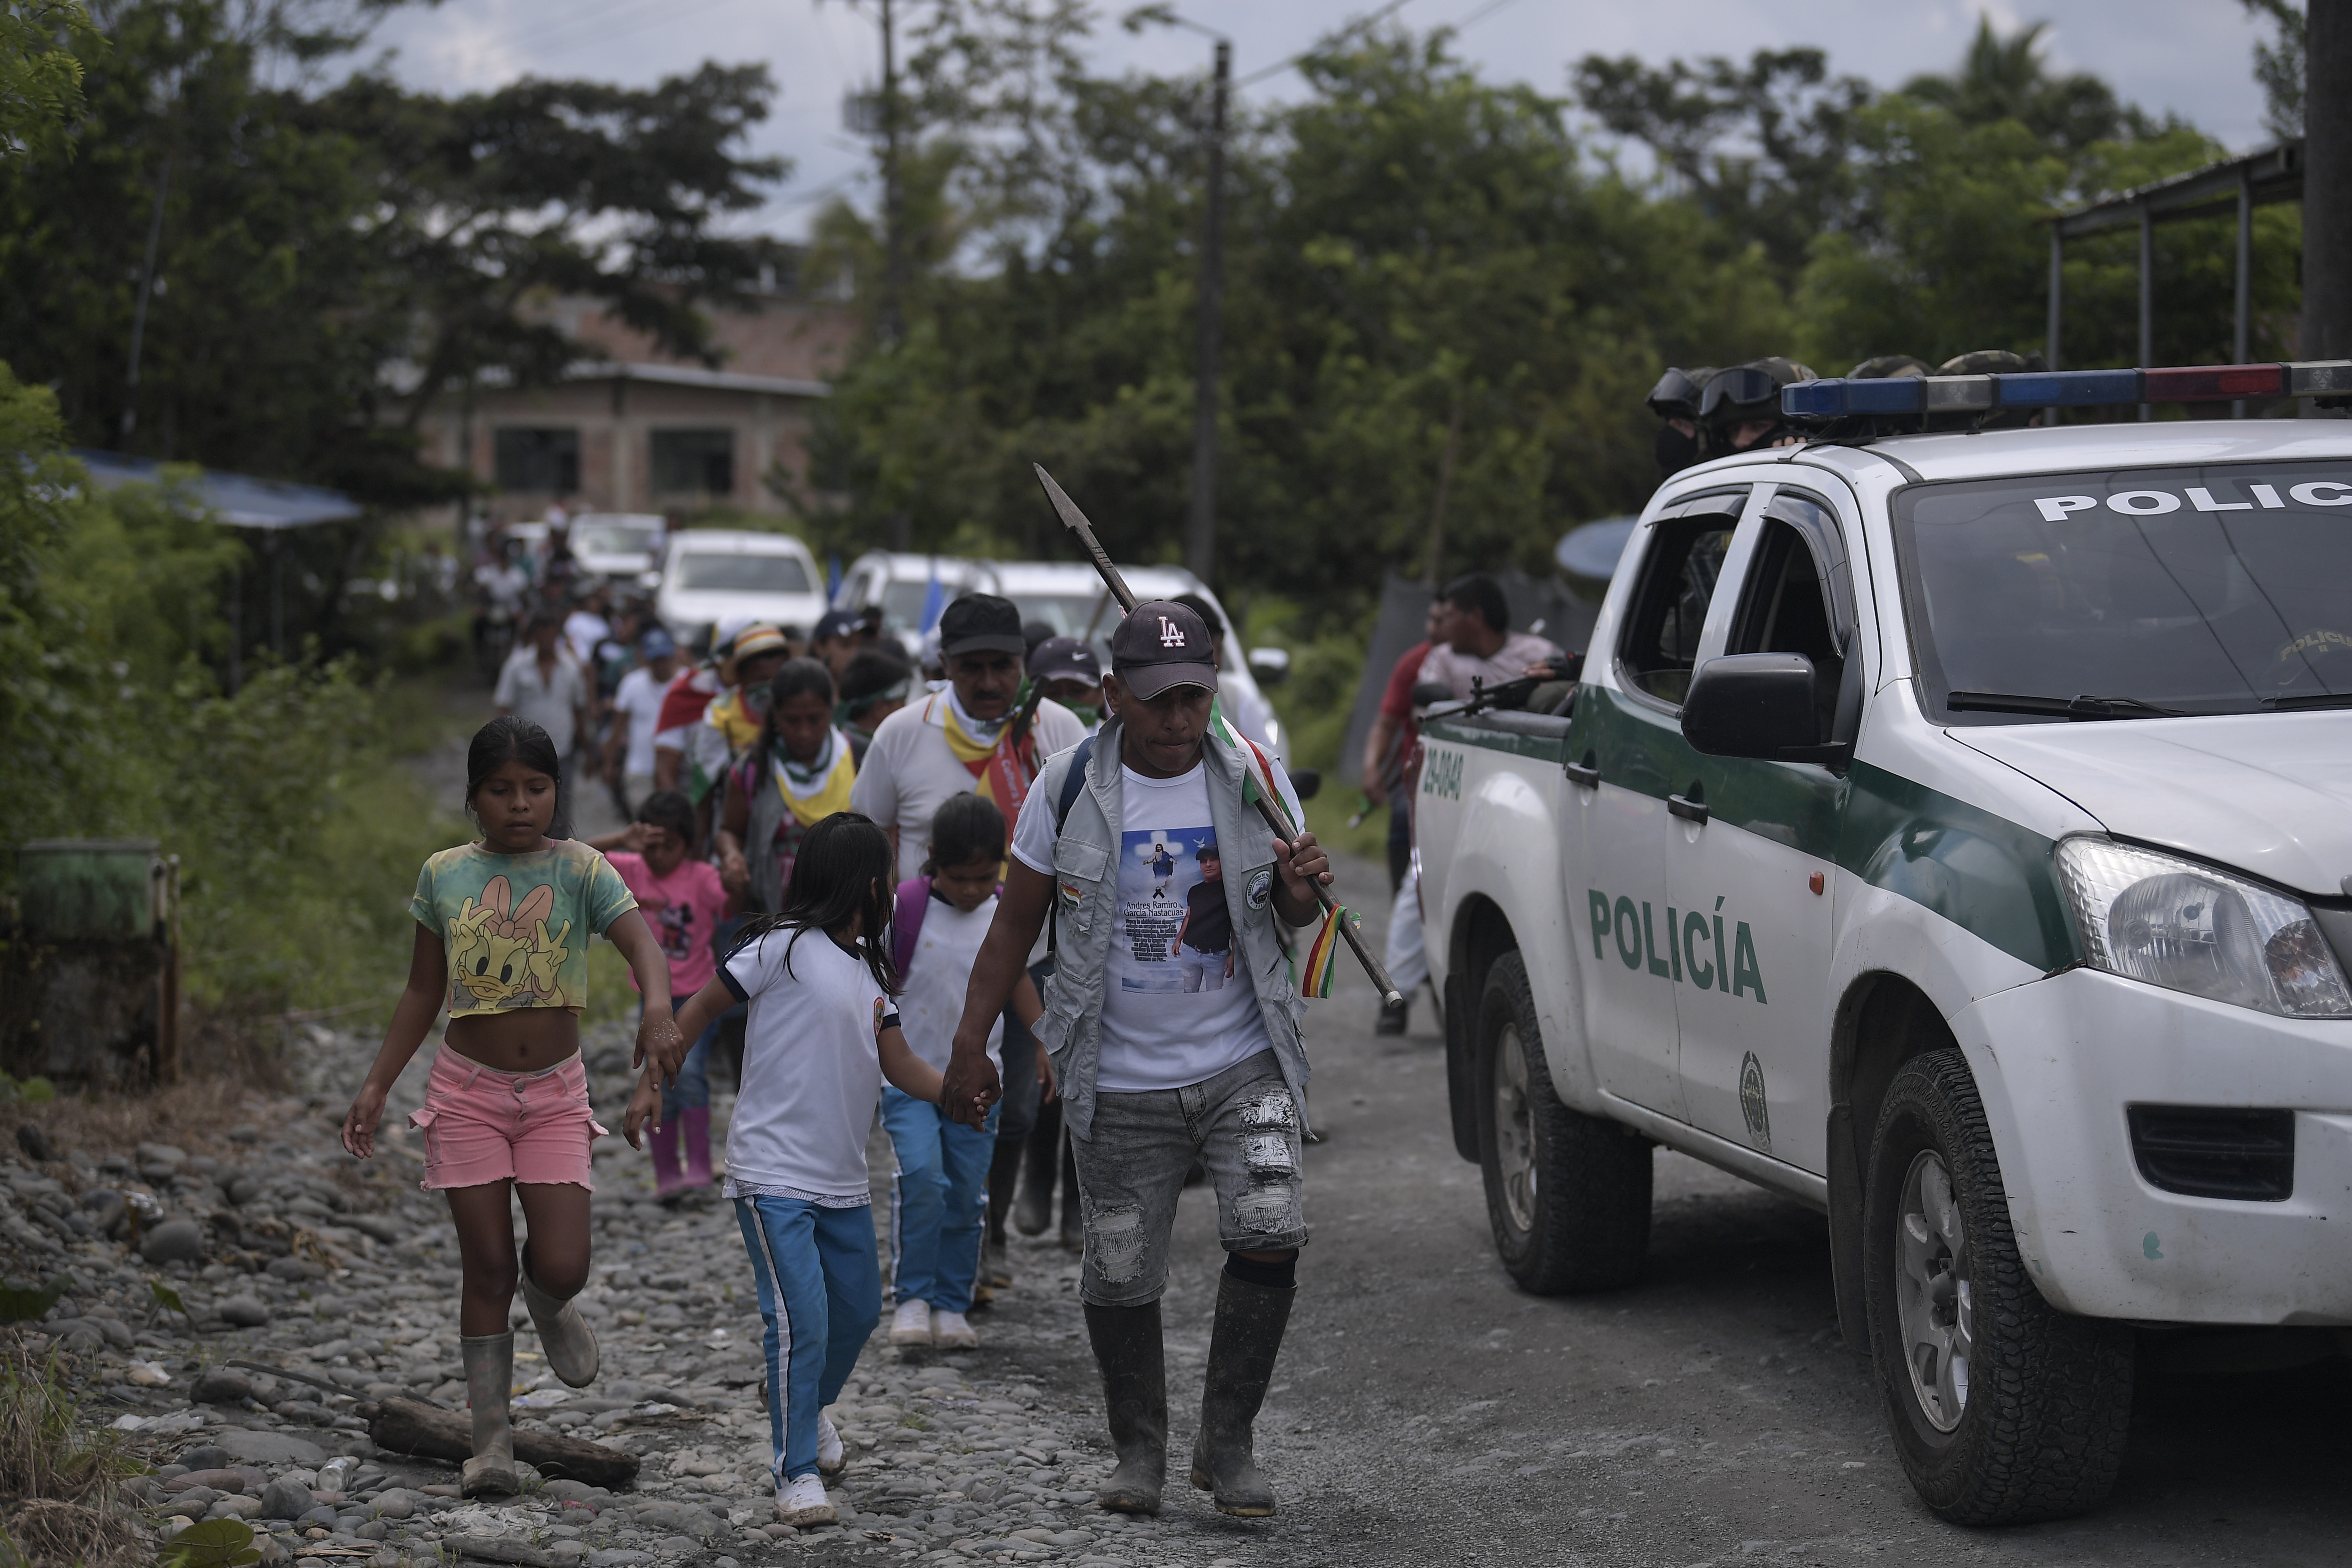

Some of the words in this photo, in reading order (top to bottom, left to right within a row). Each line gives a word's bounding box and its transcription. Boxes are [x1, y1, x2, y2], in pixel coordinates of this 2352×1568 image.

[1157, 615, 1186, 648] LA
[1152, 900, 1178, 909] Ramiro
[1589, 888, 1768, 1005] POLICÍA
